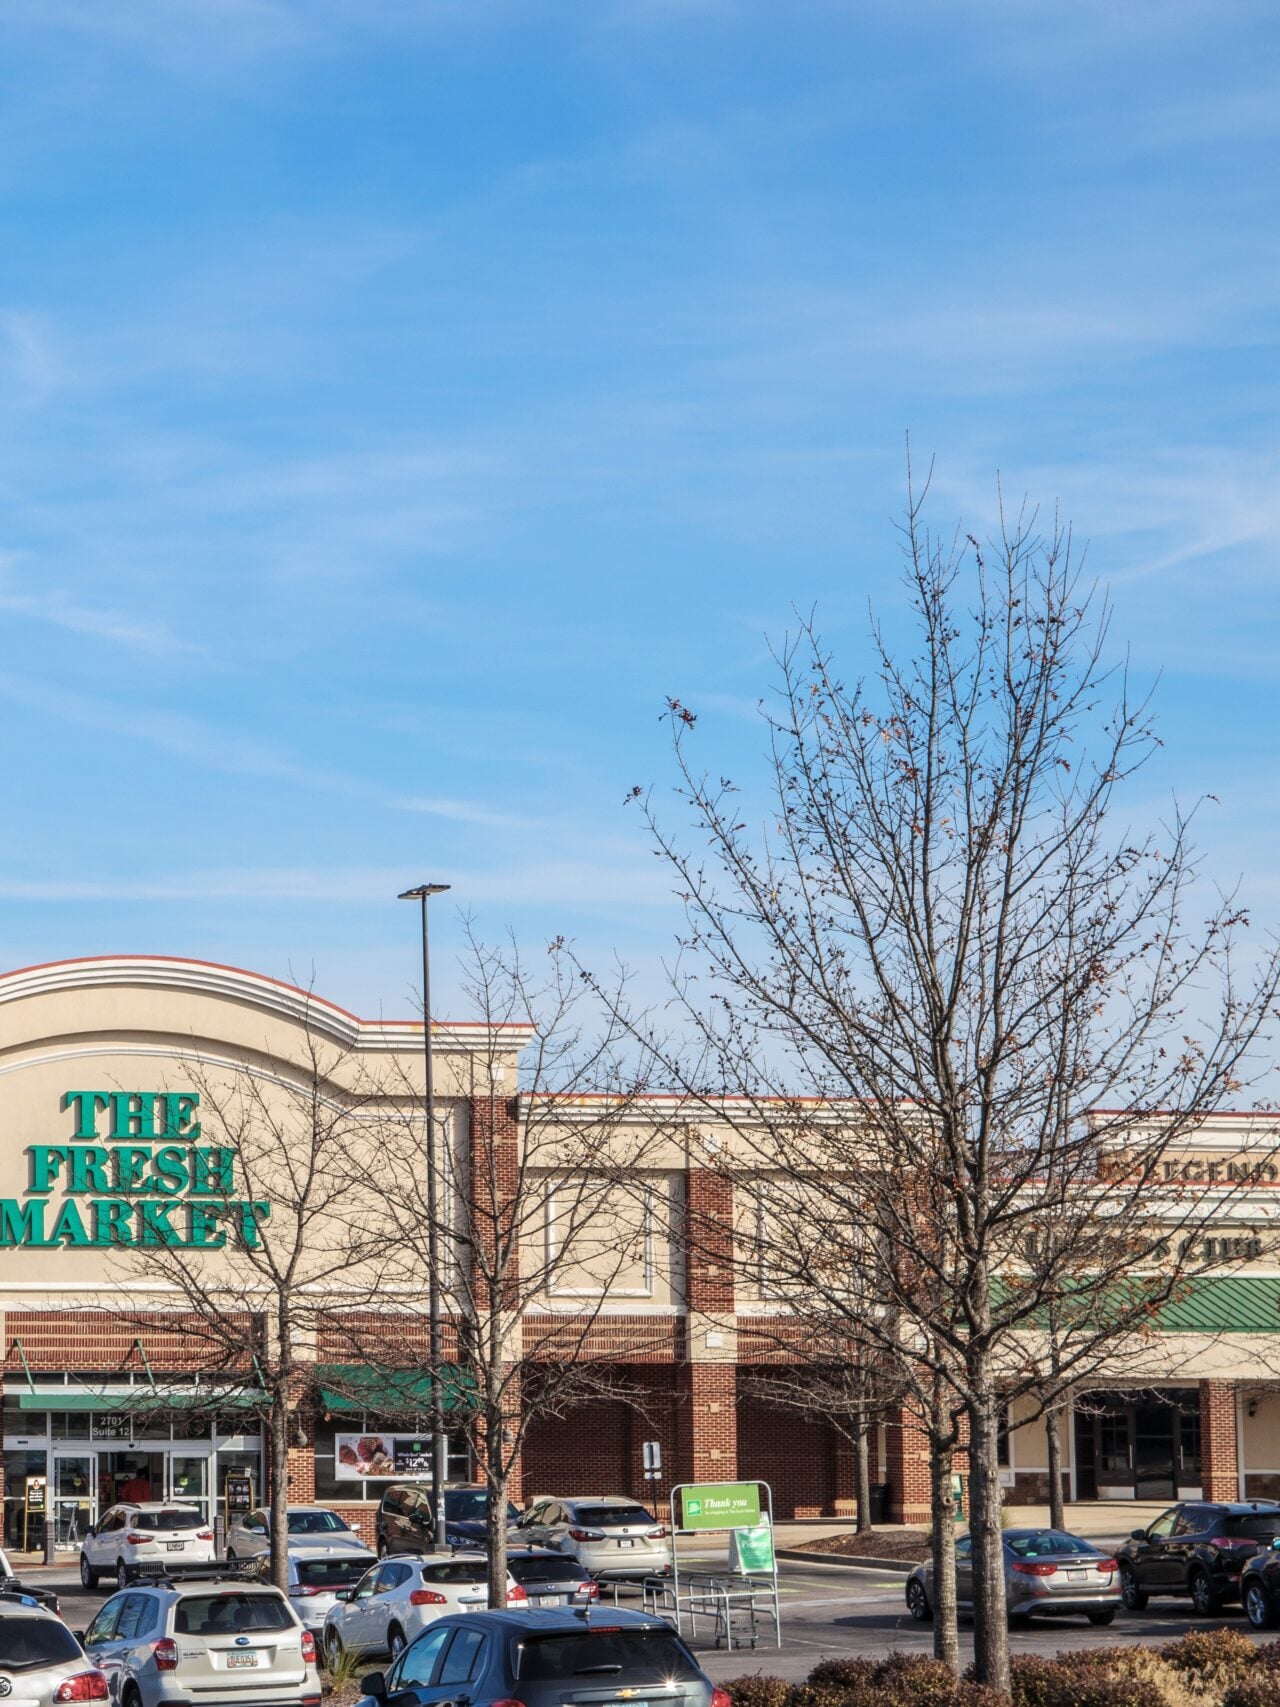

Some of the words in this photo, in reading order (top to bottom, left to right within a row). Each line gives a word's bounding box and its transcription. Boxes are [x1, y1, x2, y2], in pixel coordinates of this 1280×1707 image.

[66, 1091, 202, 1140] THE
[27, 1144, 238, 1195] FRESH
[100, 1416, 122, 1426] 2701
[92, 1427, 116, 1436] Suite
[119, 1427, 130, 1436] 12
[704, 1498, 730, 1509] Thank
[731, 1499, 747, 1509] you
